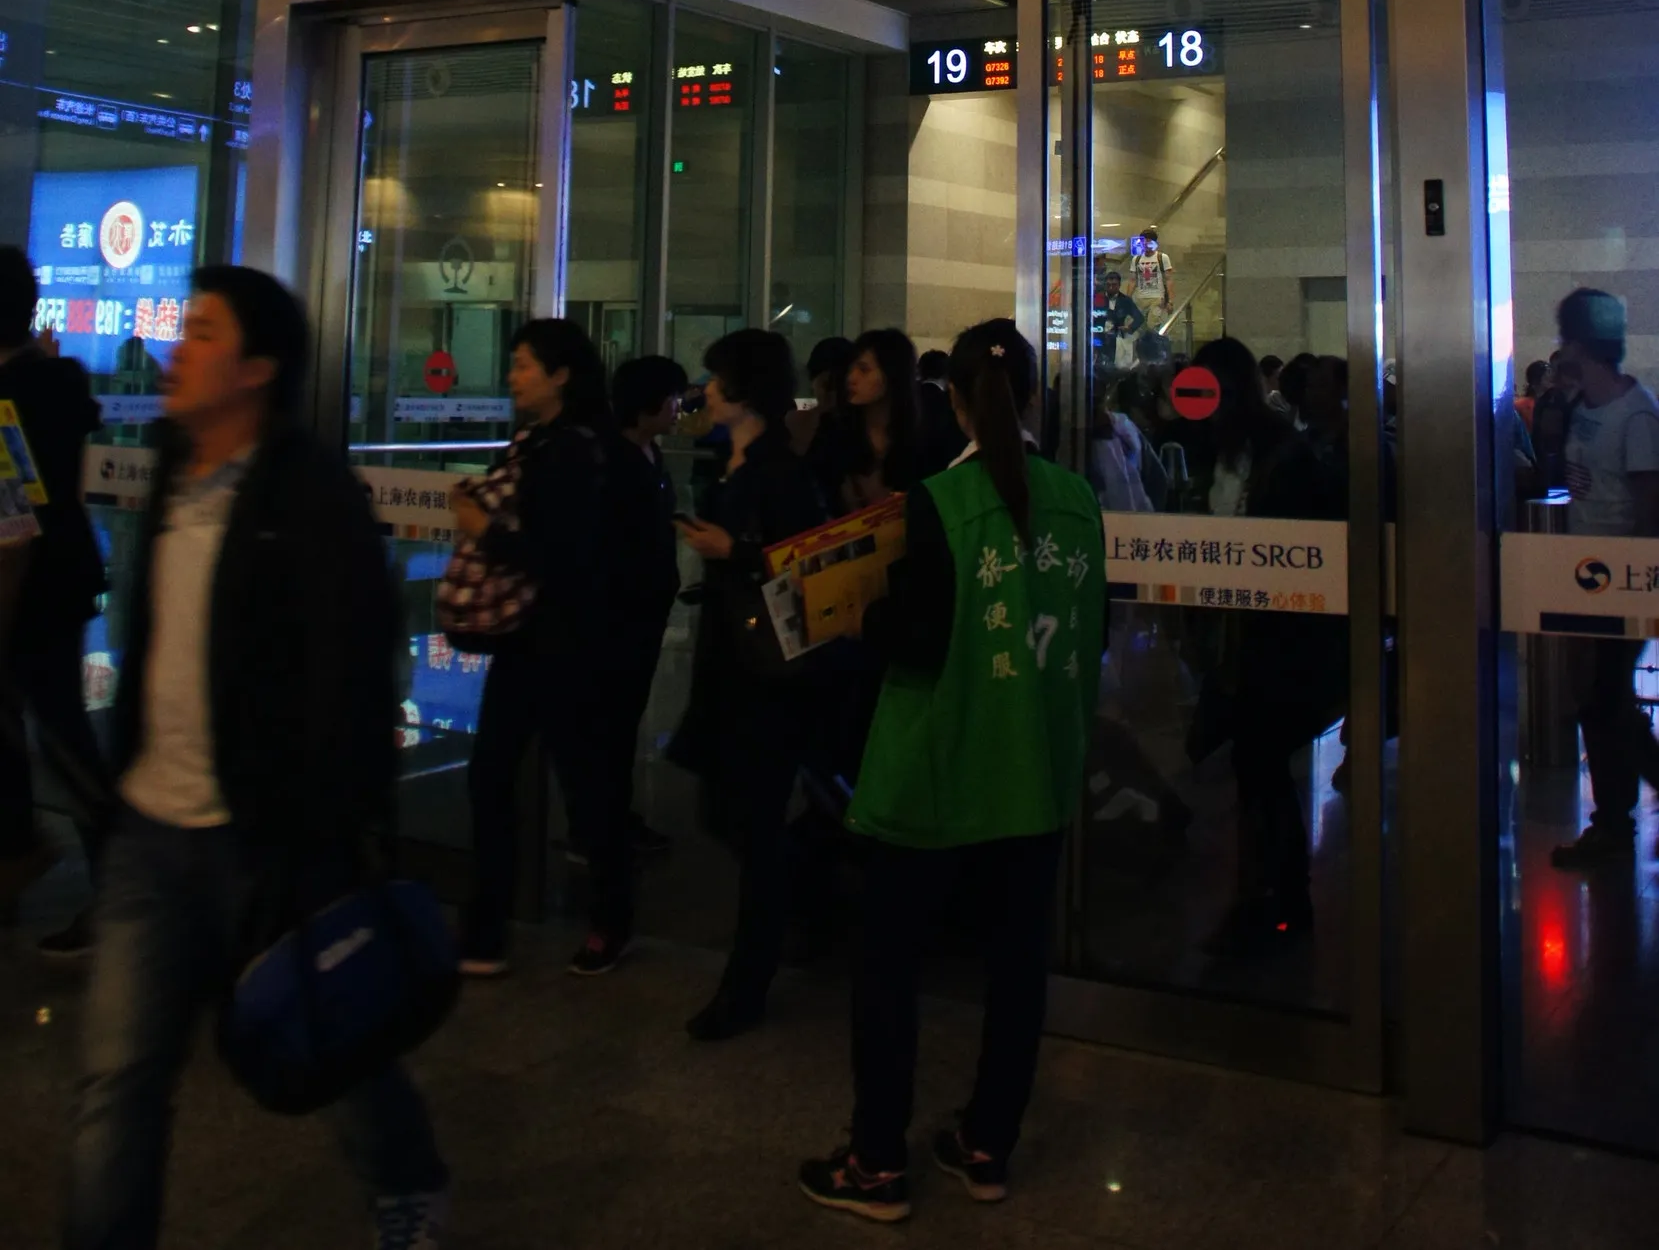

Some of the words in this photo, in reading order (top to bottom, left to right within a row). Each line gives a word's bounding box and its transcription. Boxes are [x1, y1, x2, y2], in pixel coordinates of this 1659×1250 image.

[927, 48, 967, 84] 19
[1158, 30, 1204, 68] 18
[1107, 536, 1246, 566] 上海农商银行
[1250, 544, 1324, 569] SRCB
